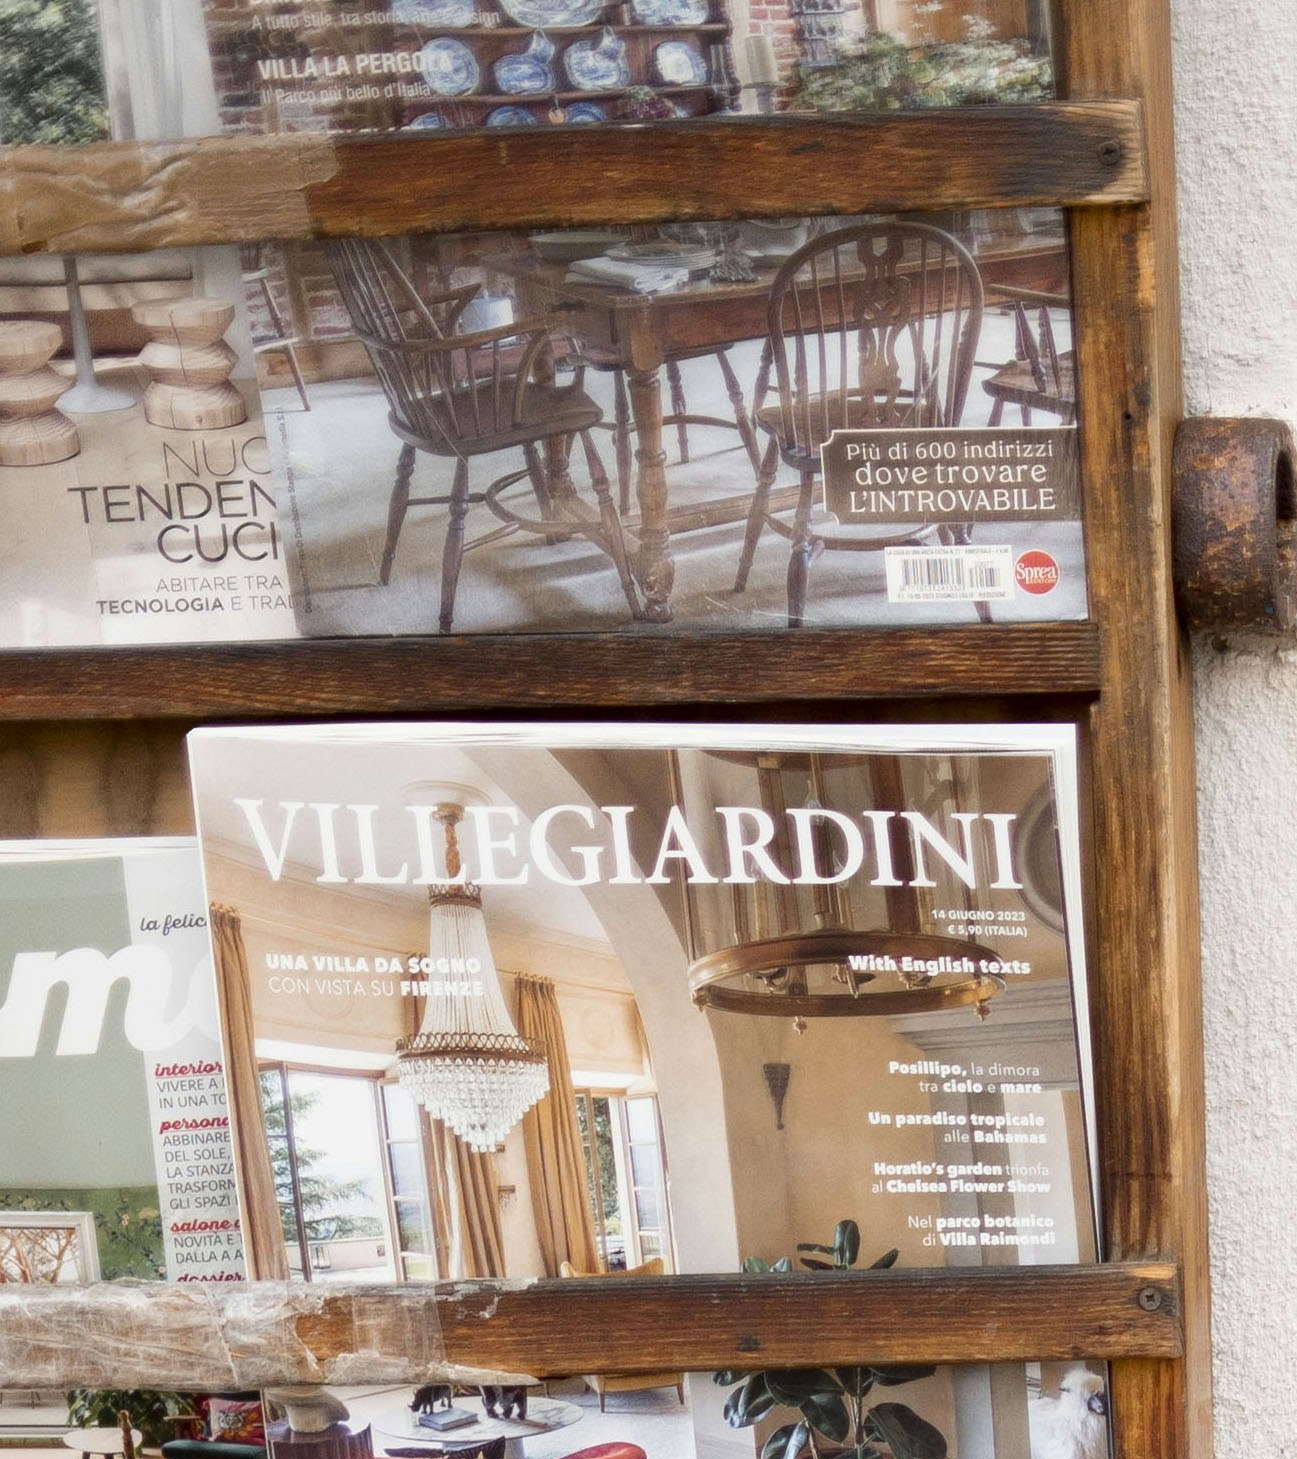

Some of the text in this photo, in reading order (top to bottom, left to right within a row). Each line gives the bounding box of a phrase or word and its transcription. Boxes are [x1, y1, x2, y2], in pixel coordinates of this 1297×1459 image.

[356, 52, 451, 74] PERGOLA
[847, 440, 1053, 460] Più 600 indirizzi
[855, 462, 1047, 485] dove trovare
[1016, 563, 1058, 584] Sprea
[156, 576, 238, 593] ABITARE
[97, 597, 224, 614] TECNOLOGIA
[234, 799, 1023, 890] VILLEGIARDINI
[948, 910, 1025, 921] GIUGNO 2023
[265, 953, 370, 973] UNA VILLA
[849, 955, 1030, 976] With English texts
[269, 976, 365, 996] CON VISTA
[889, 1061, 967, 1077] Posillipo,
[896, 1112, 1045, 1129] paradiso tropicale
[974, 1131, 1047, 1144] Bahamas
